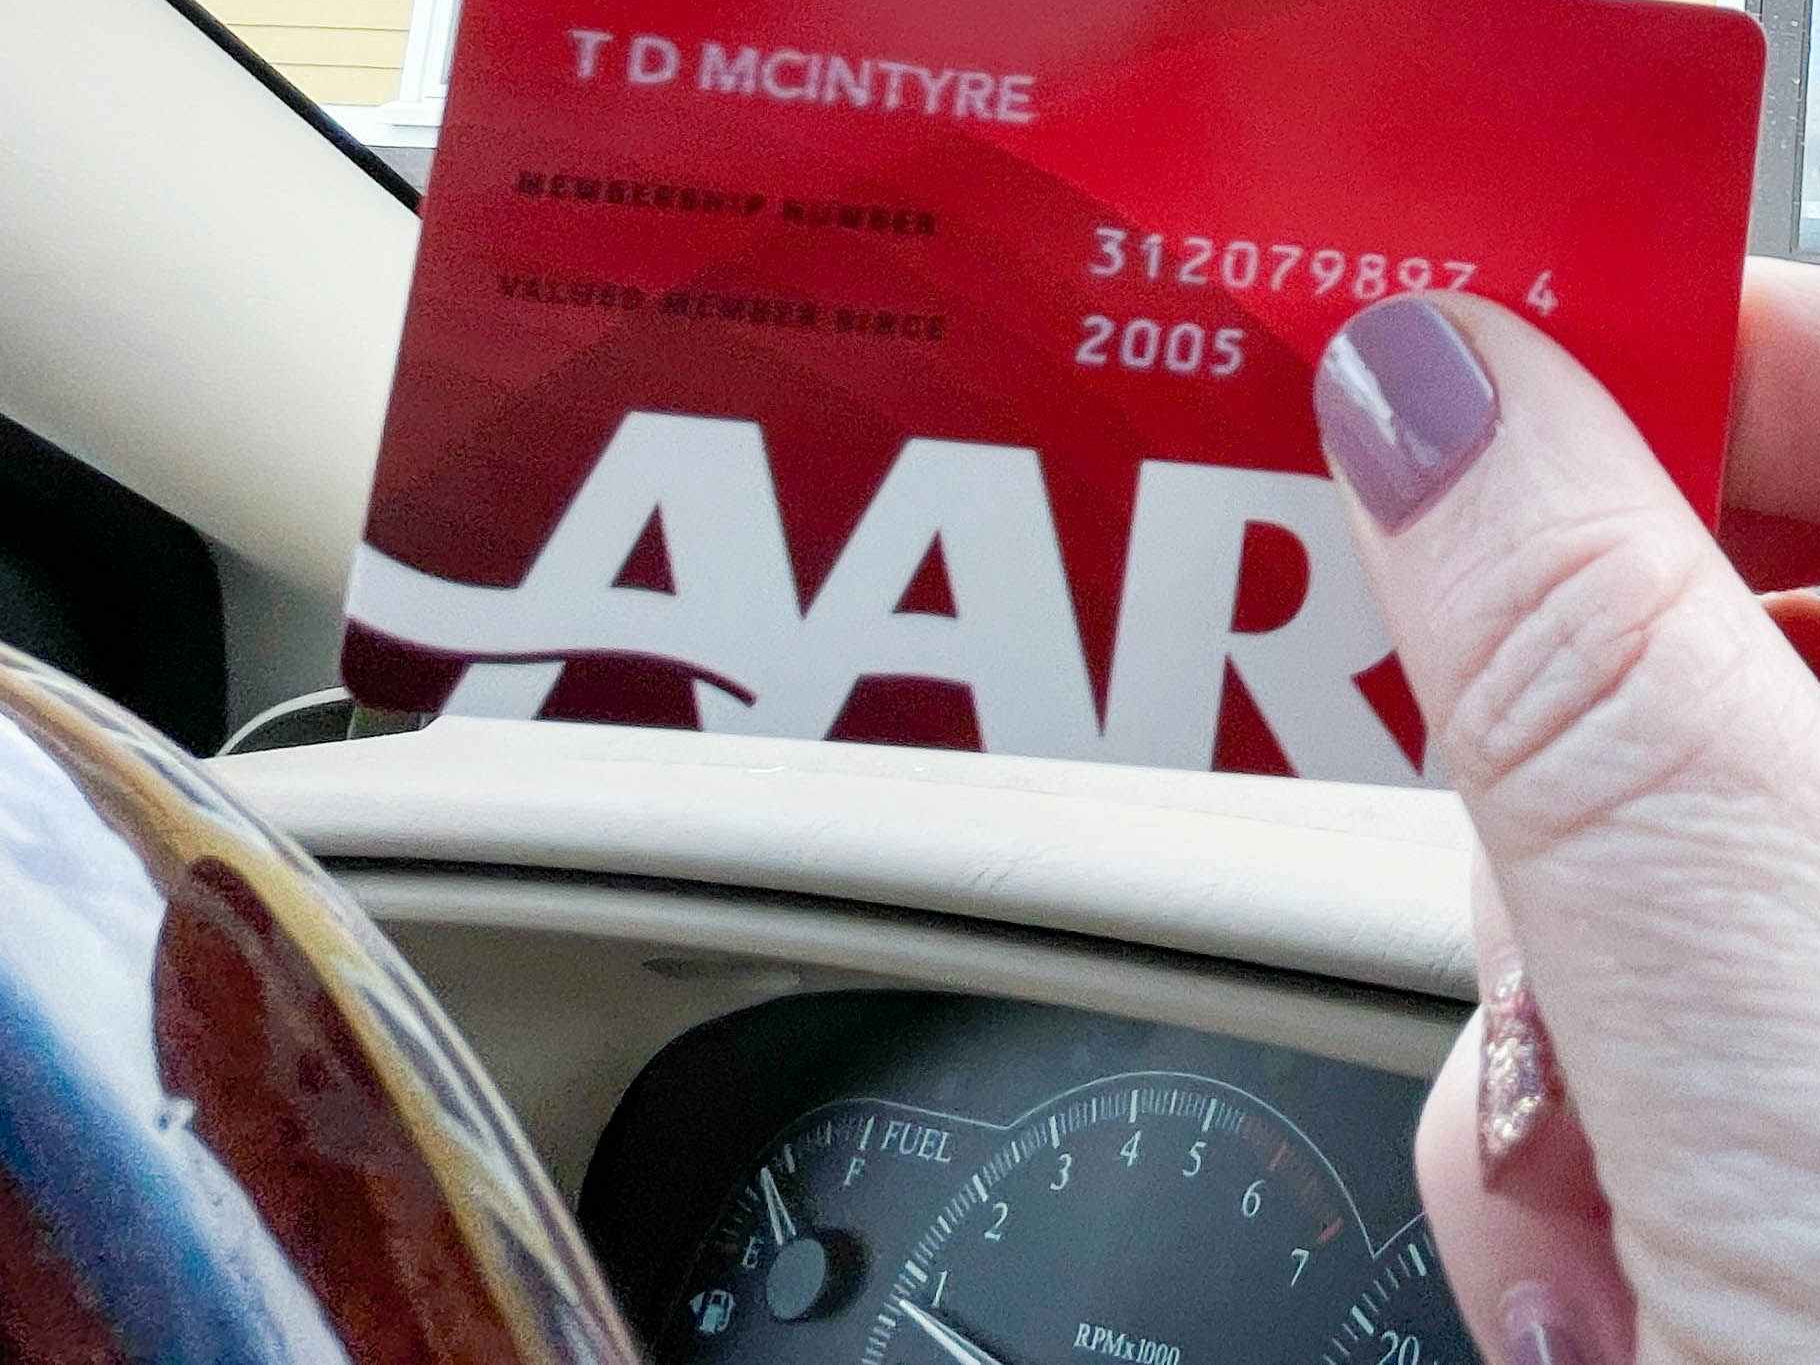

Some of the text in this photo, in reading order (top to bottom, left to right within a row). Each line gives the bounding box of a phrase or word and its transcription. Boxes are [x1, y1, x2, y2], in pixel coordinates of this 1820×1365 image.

[568, 28, 1036, 124] T D MCINTYRE
[1522, 271, 1559, 315] 4
[1073, 314, 1247, 376] 2005
[345, 411, 1422, 780] AAR
[881, 1120, 952, 1163] FUEL
[1119, 1131, 1142, 1168] 4
[1182, 1141, 1207, 1178] 5
[844, 1157, 866, 1185] F
[1049, 1153, 1073, 1191] 3
[1240, 1180, 1266, 1219] 6
[984, 1201, 1010, 1242] 2
[742, 1236, 765, 1269] E
[1289, 1248, 1310, 1288] 7
[932, 1271, 949, 1308] 1
[1073, 1322, 1182, 1365] RPMx1000
[1378, 1331, 1421, 1365] 20
